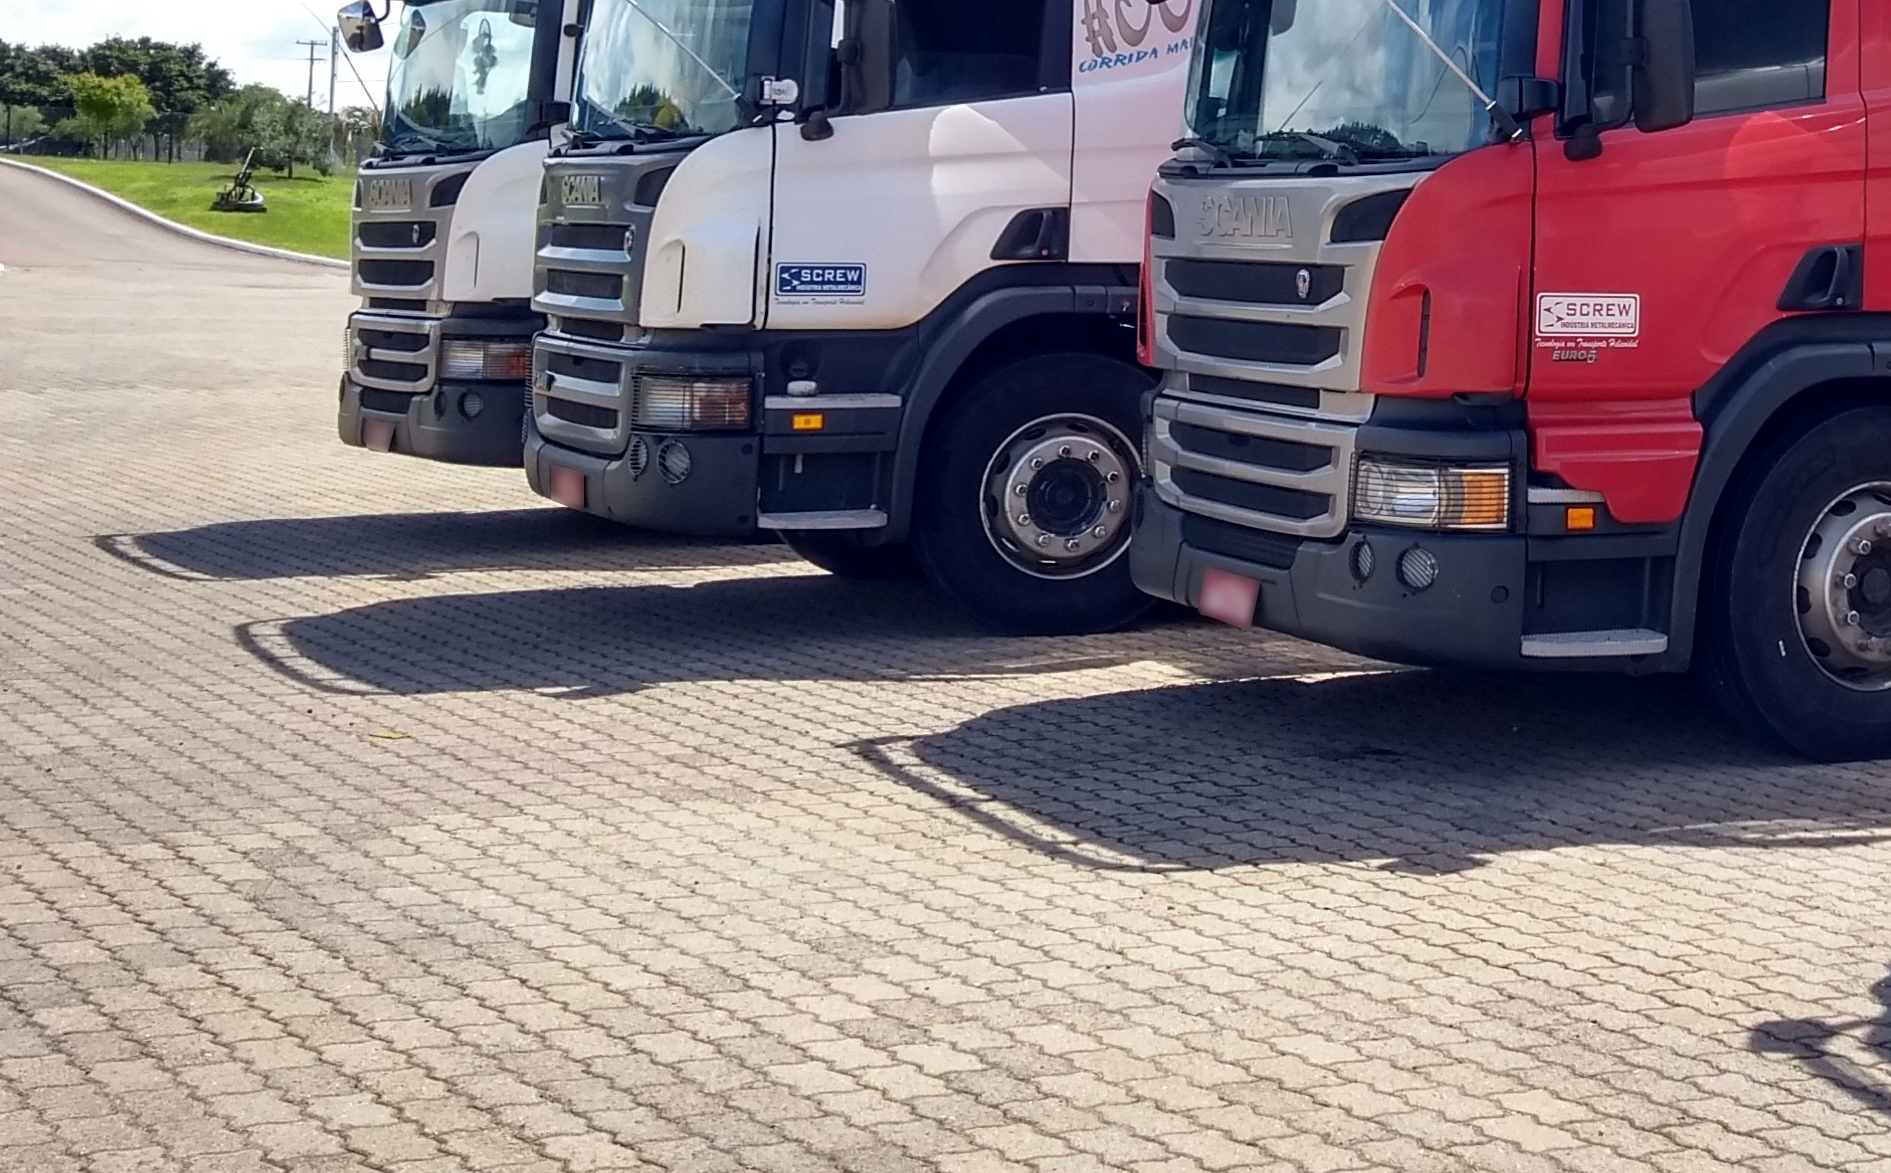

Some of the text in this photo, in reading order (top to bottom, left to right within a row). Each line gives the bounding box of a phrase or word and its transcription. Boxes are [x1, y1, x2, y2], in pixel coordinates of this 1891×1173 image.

[1078, 47, 1159, 73] CORRIDA
[370, 179, 412, 206] SCANIA
[562, 175, 601, 204] SCANIA
[1197, 196, 1293, 238] SCANIA
[800, 269, 860, 282] SCREW
[1566, 303, 1632, 317] SCREW
